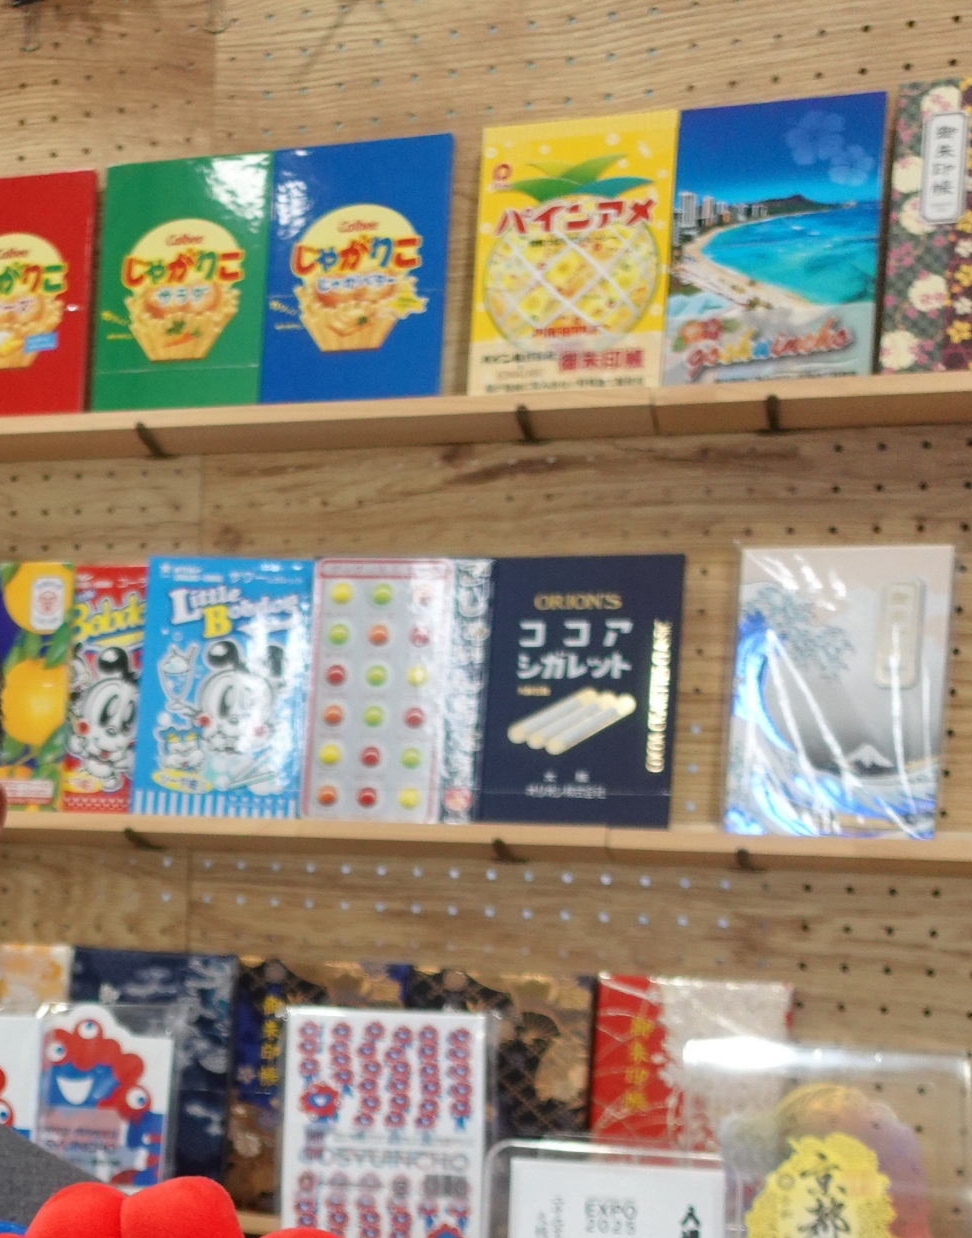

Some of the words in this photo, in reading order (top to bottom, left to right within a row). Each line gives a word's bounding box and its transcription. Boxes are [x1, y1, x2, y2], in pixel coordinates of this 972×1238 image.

[495, 199, 655, 236] パインアメ
[122, 250, 244, 290] じゃがりこ
[292, 236, 421, 275] じゃがりこ
[518, 618, 634, 648] ココア
[517, 652, 632, 680] シガレット
[584, 1199, 637, 1220] EXPO
[585, 1219, 637, 1236] 2025
